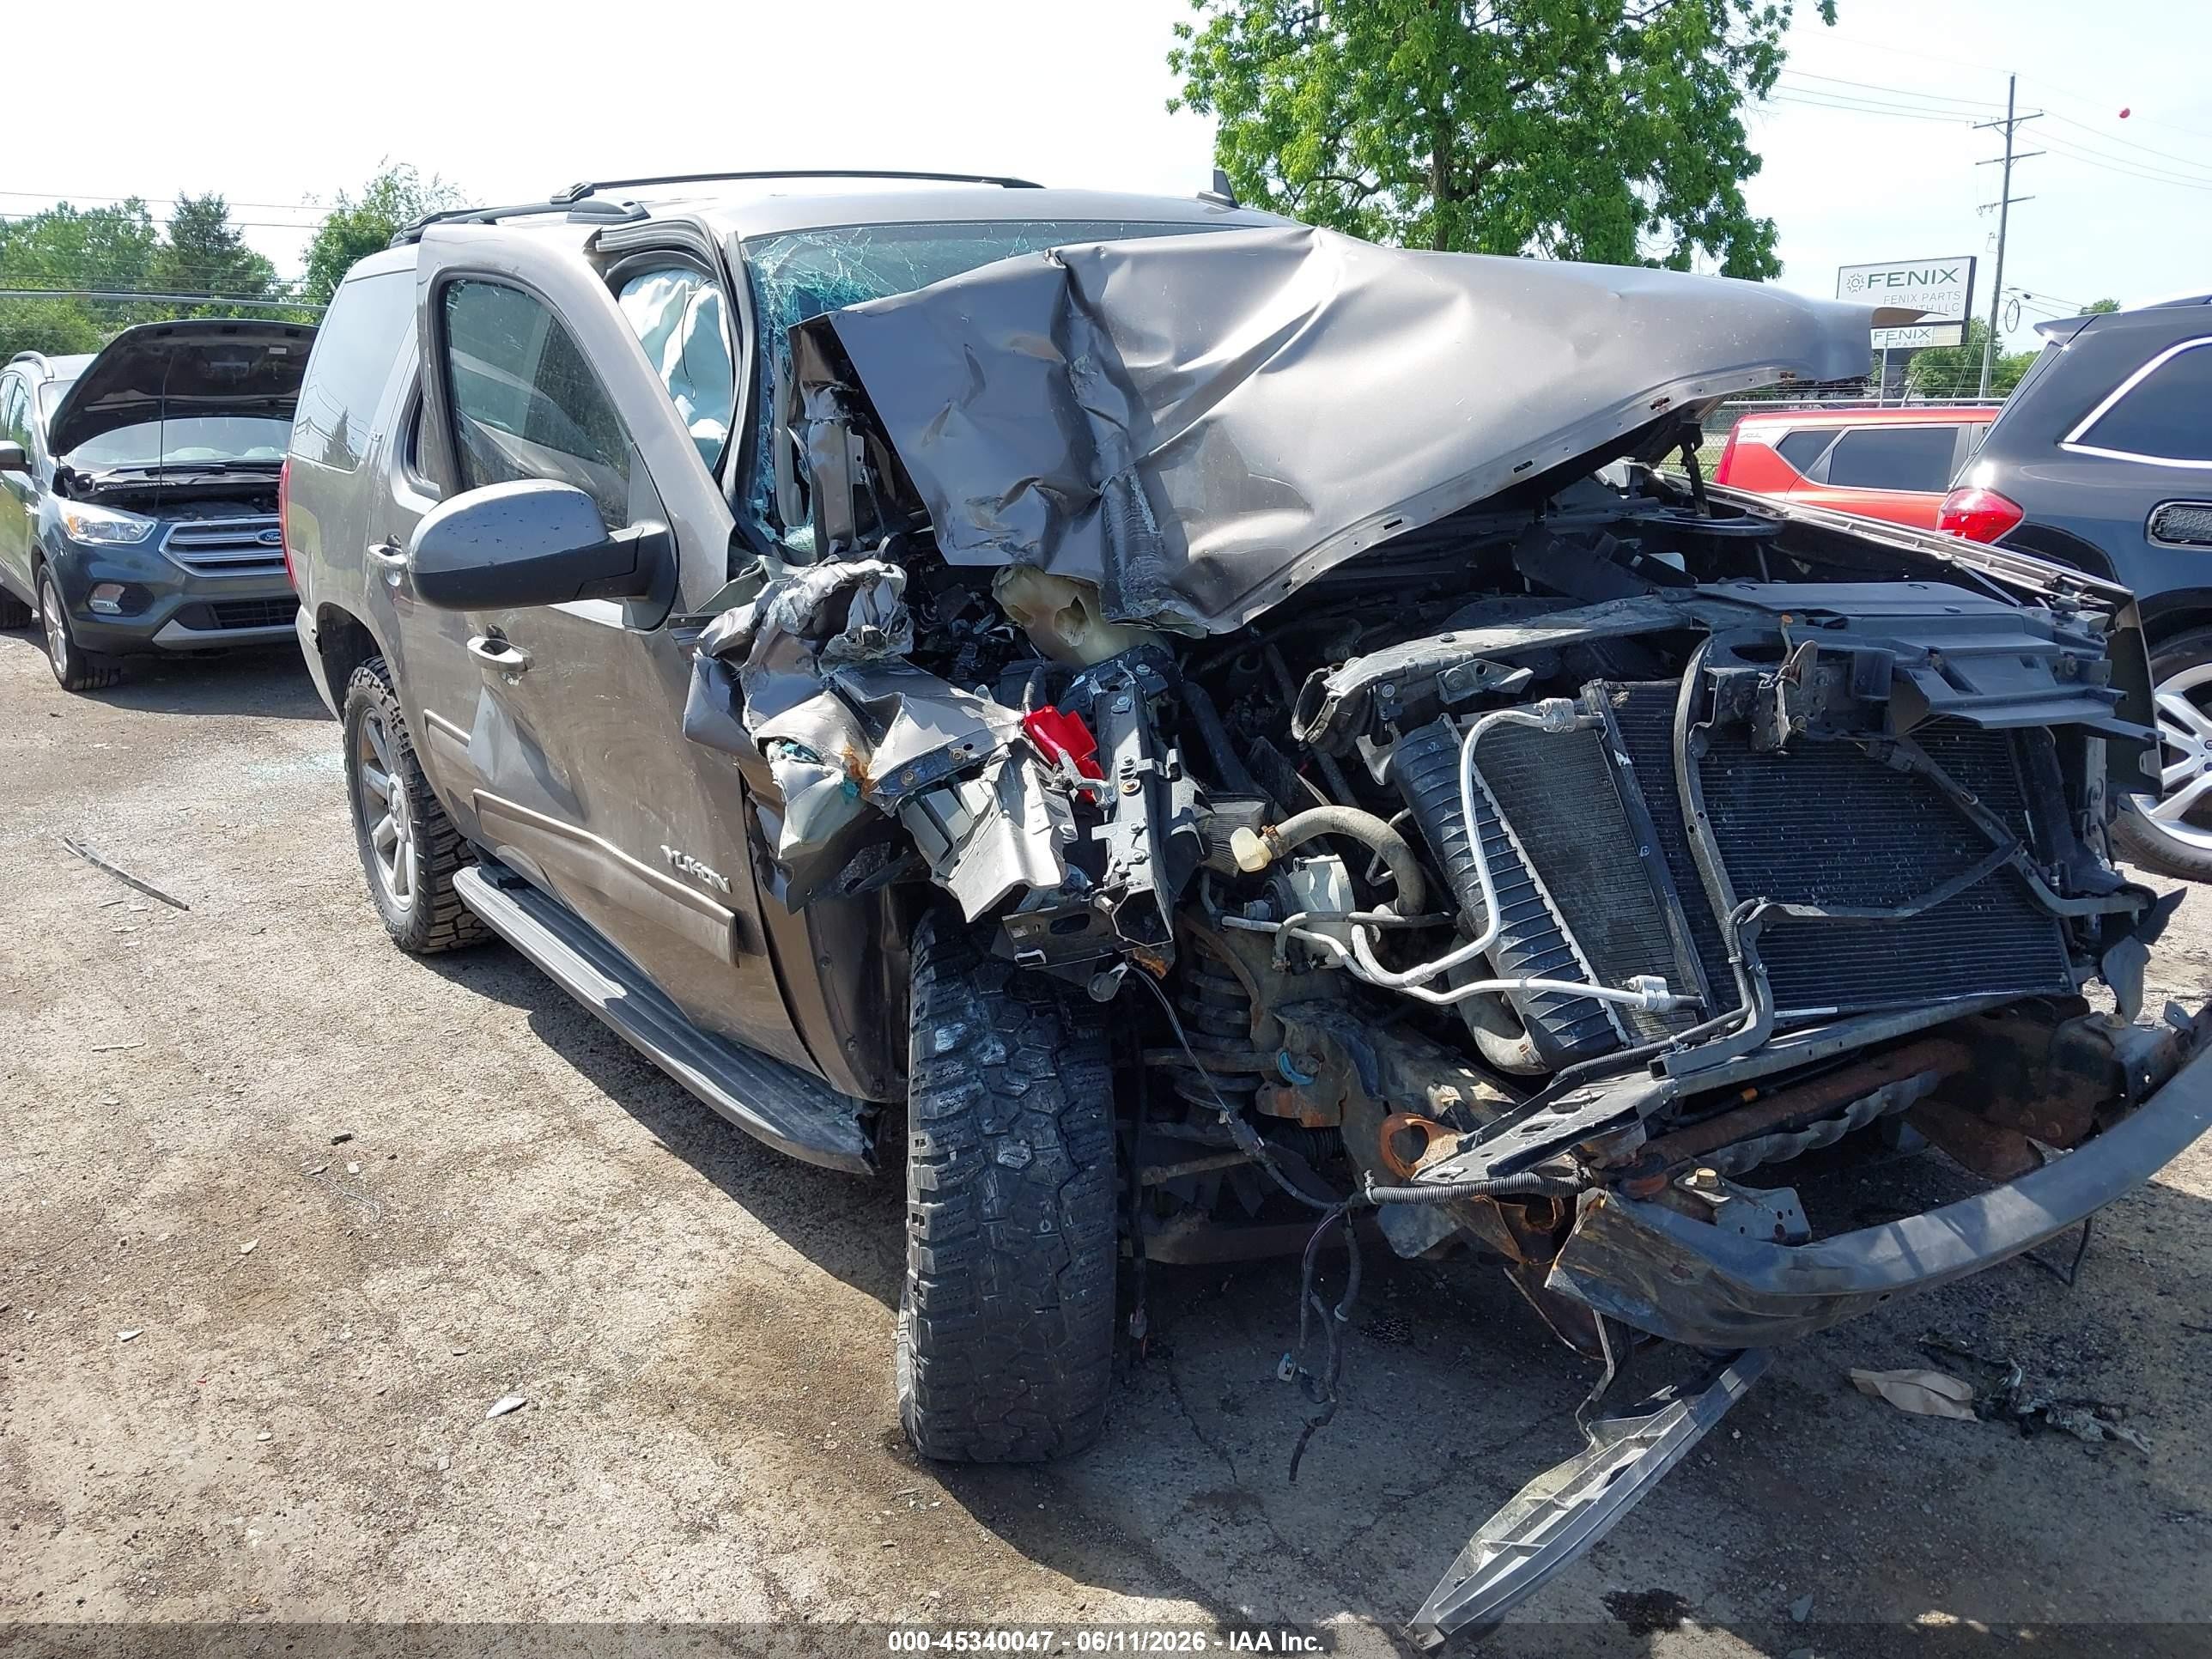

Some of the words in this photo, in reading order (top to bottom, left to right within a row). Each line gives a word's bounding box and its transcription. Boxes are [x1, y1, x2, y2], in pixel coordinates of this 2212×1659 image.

[1868, 267, 1960, 289] FENIX
[1883, 294, 1917, 305] FENIX
[1922, 290, 1961, 301] PARTS
[1938, 302, 1960, 313] LLC
[1874, 328, 1931, 342] FENIX
[660, 844, 731, 894] YUKON
